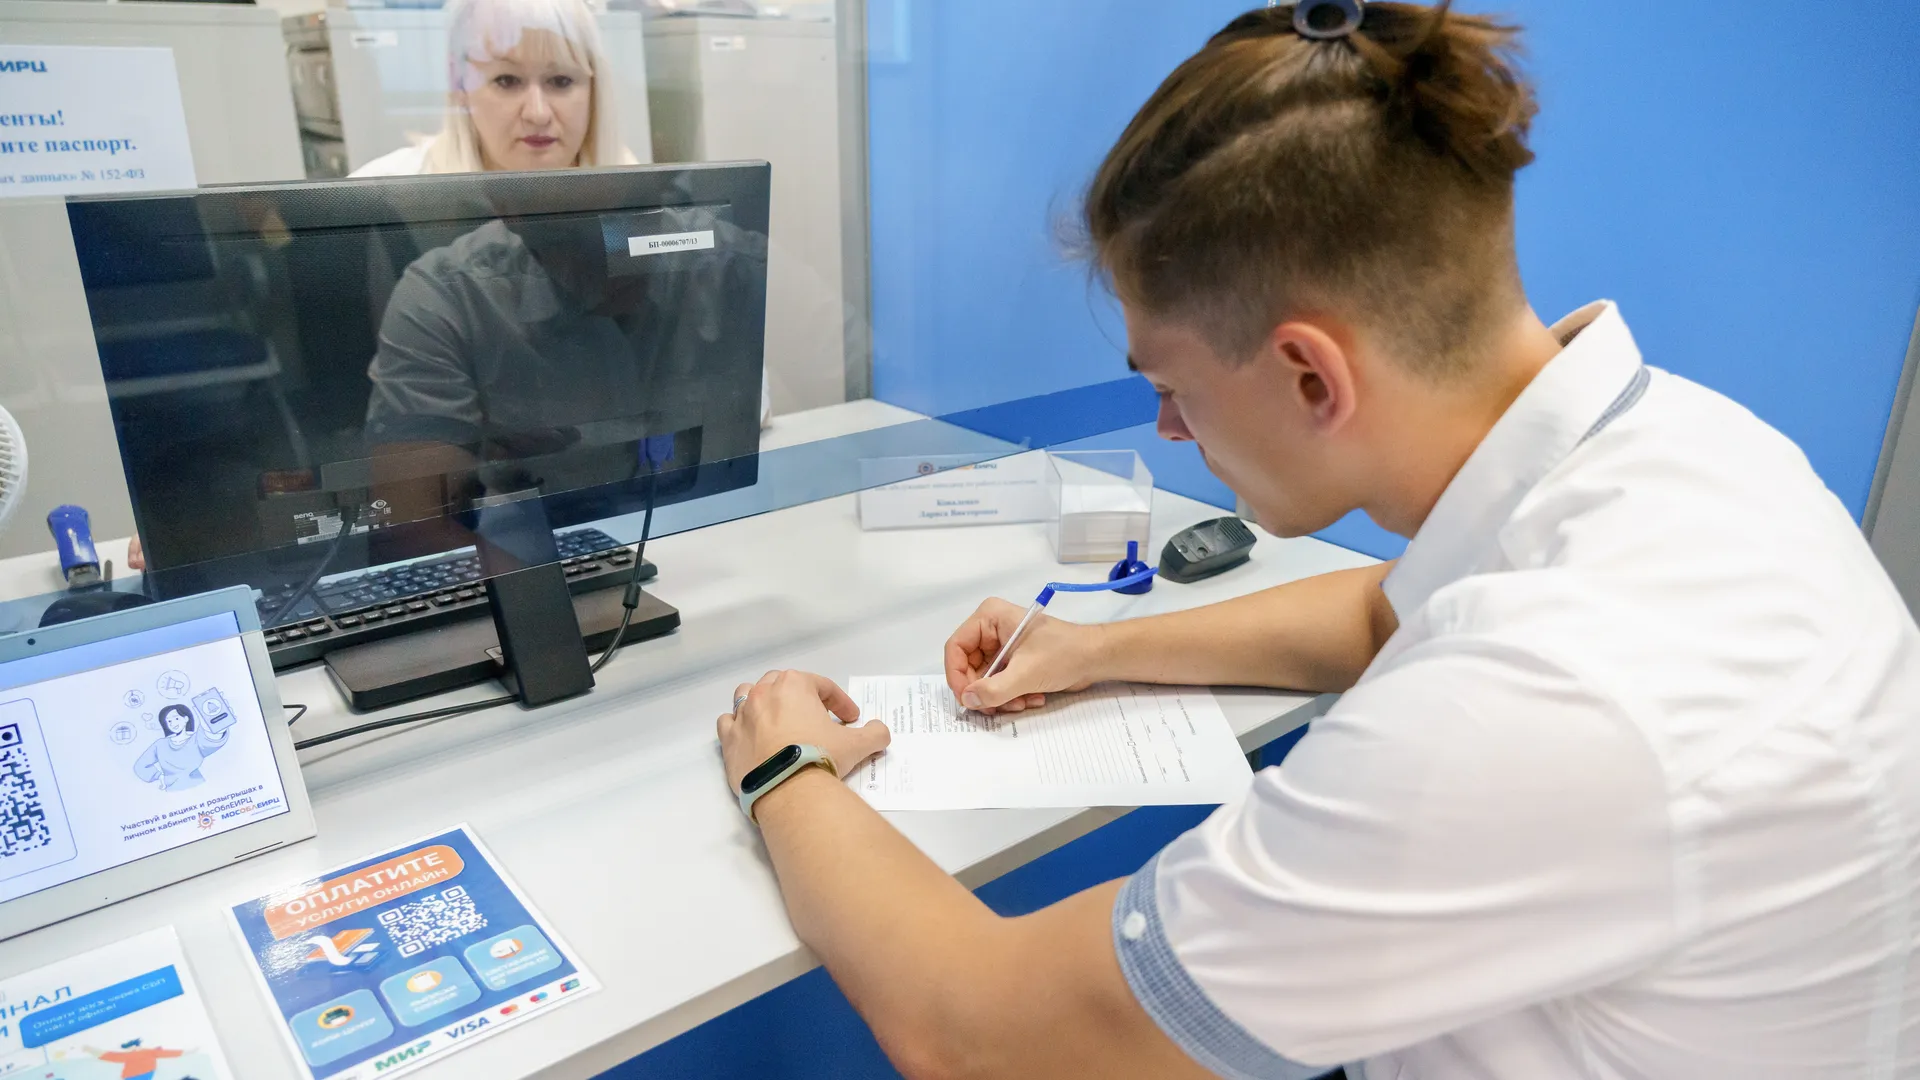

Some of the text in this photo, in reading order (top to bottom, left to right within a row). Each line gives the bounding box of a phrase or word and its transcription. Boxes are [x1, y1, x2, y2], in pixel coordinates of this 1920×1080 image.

[0, 109, 64, 127] енты!
[0, 138, 138, 156] ите паспорт.
[81, 169, 96, 181] №
[100, 168, 145, 180] 152-ФЗ
[120, 813, 160, 832] Участвуй
[161, 812, 168, 820] в
[169, 804, 198, 819] акциях
[206, 787, 258, 807] розыгрышах
[123, 828, 157, 842] личном
[158, 815, 197, 831] кабинете
[198, 796, 253, 818] МосОблЕИРЦ
[284, 851, 444, 916] ОПЛАТИТЕ
[295, 867, 449, 927] УСЛУГИ ОНЛАЙН
[445, 1016, 490, 1039] VISA
[374, 1040, 432, 1072] МИР
